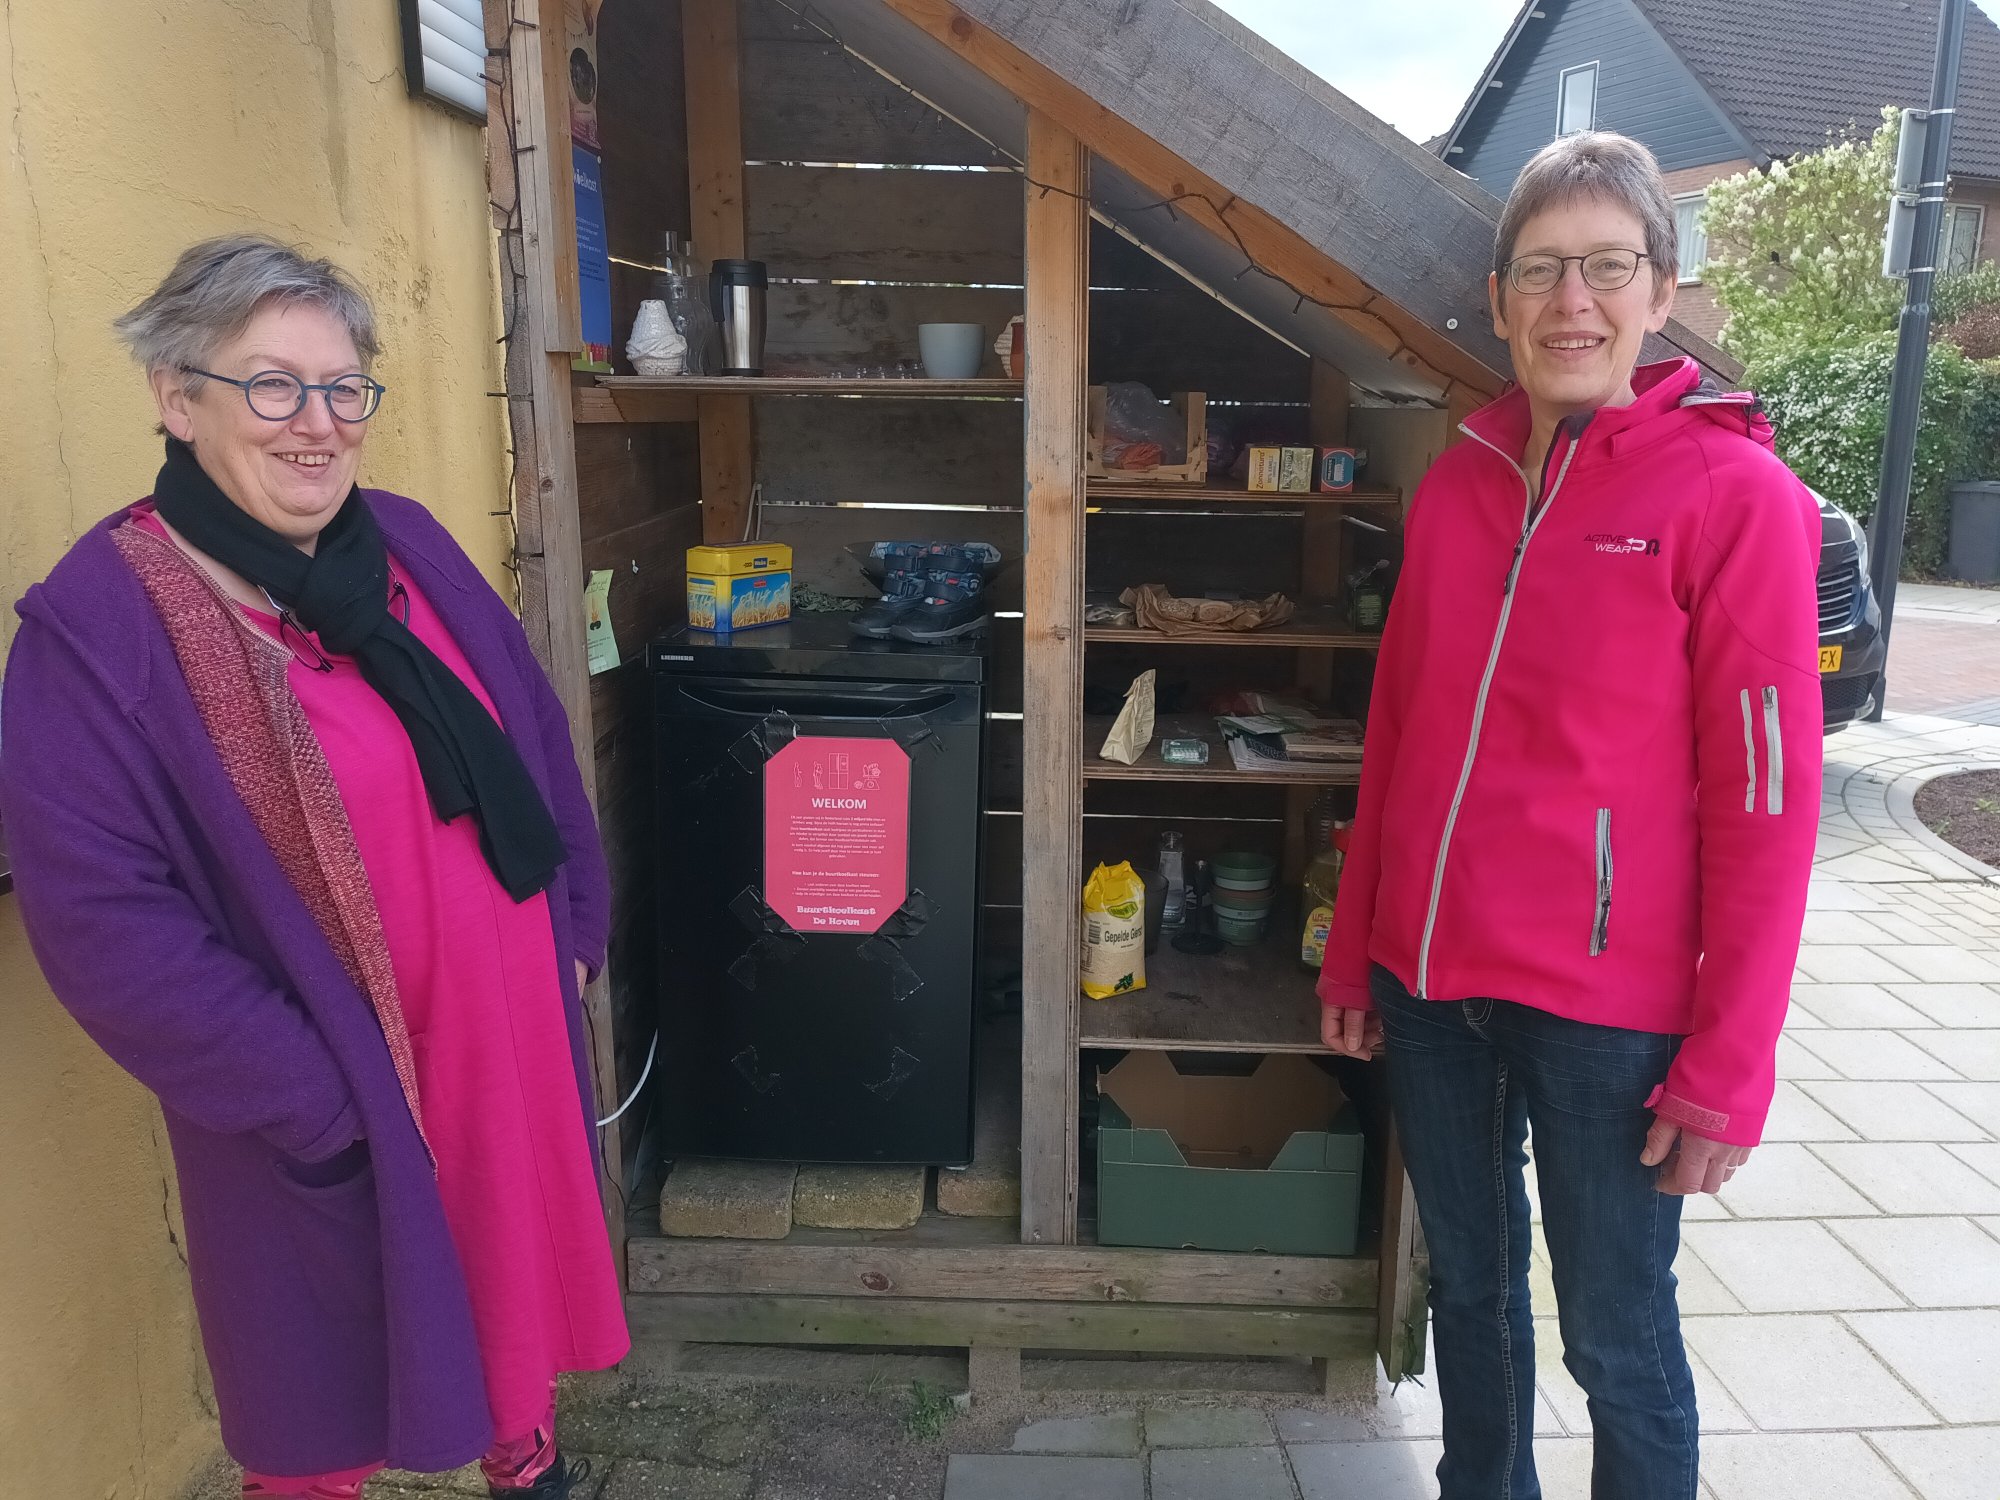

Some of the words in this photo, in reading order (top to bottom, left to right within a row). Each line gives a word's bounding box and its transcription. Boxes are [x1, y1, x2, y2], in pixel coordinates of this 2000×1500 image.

[1257, 452, 1266, 489] Zonnatura
[1584, 533, 1627, 544] ACTIVE
[1595, 542, 1632, 554] WEAR
[811, 797, 867, 810] WELKOM
[796, 906, 876, 915] Buurtkoelkast
[813, 917, 826, 925] De
[829, 917, 860, 926] Hoven
[1104, 929, 1130, 945] Gepelde
